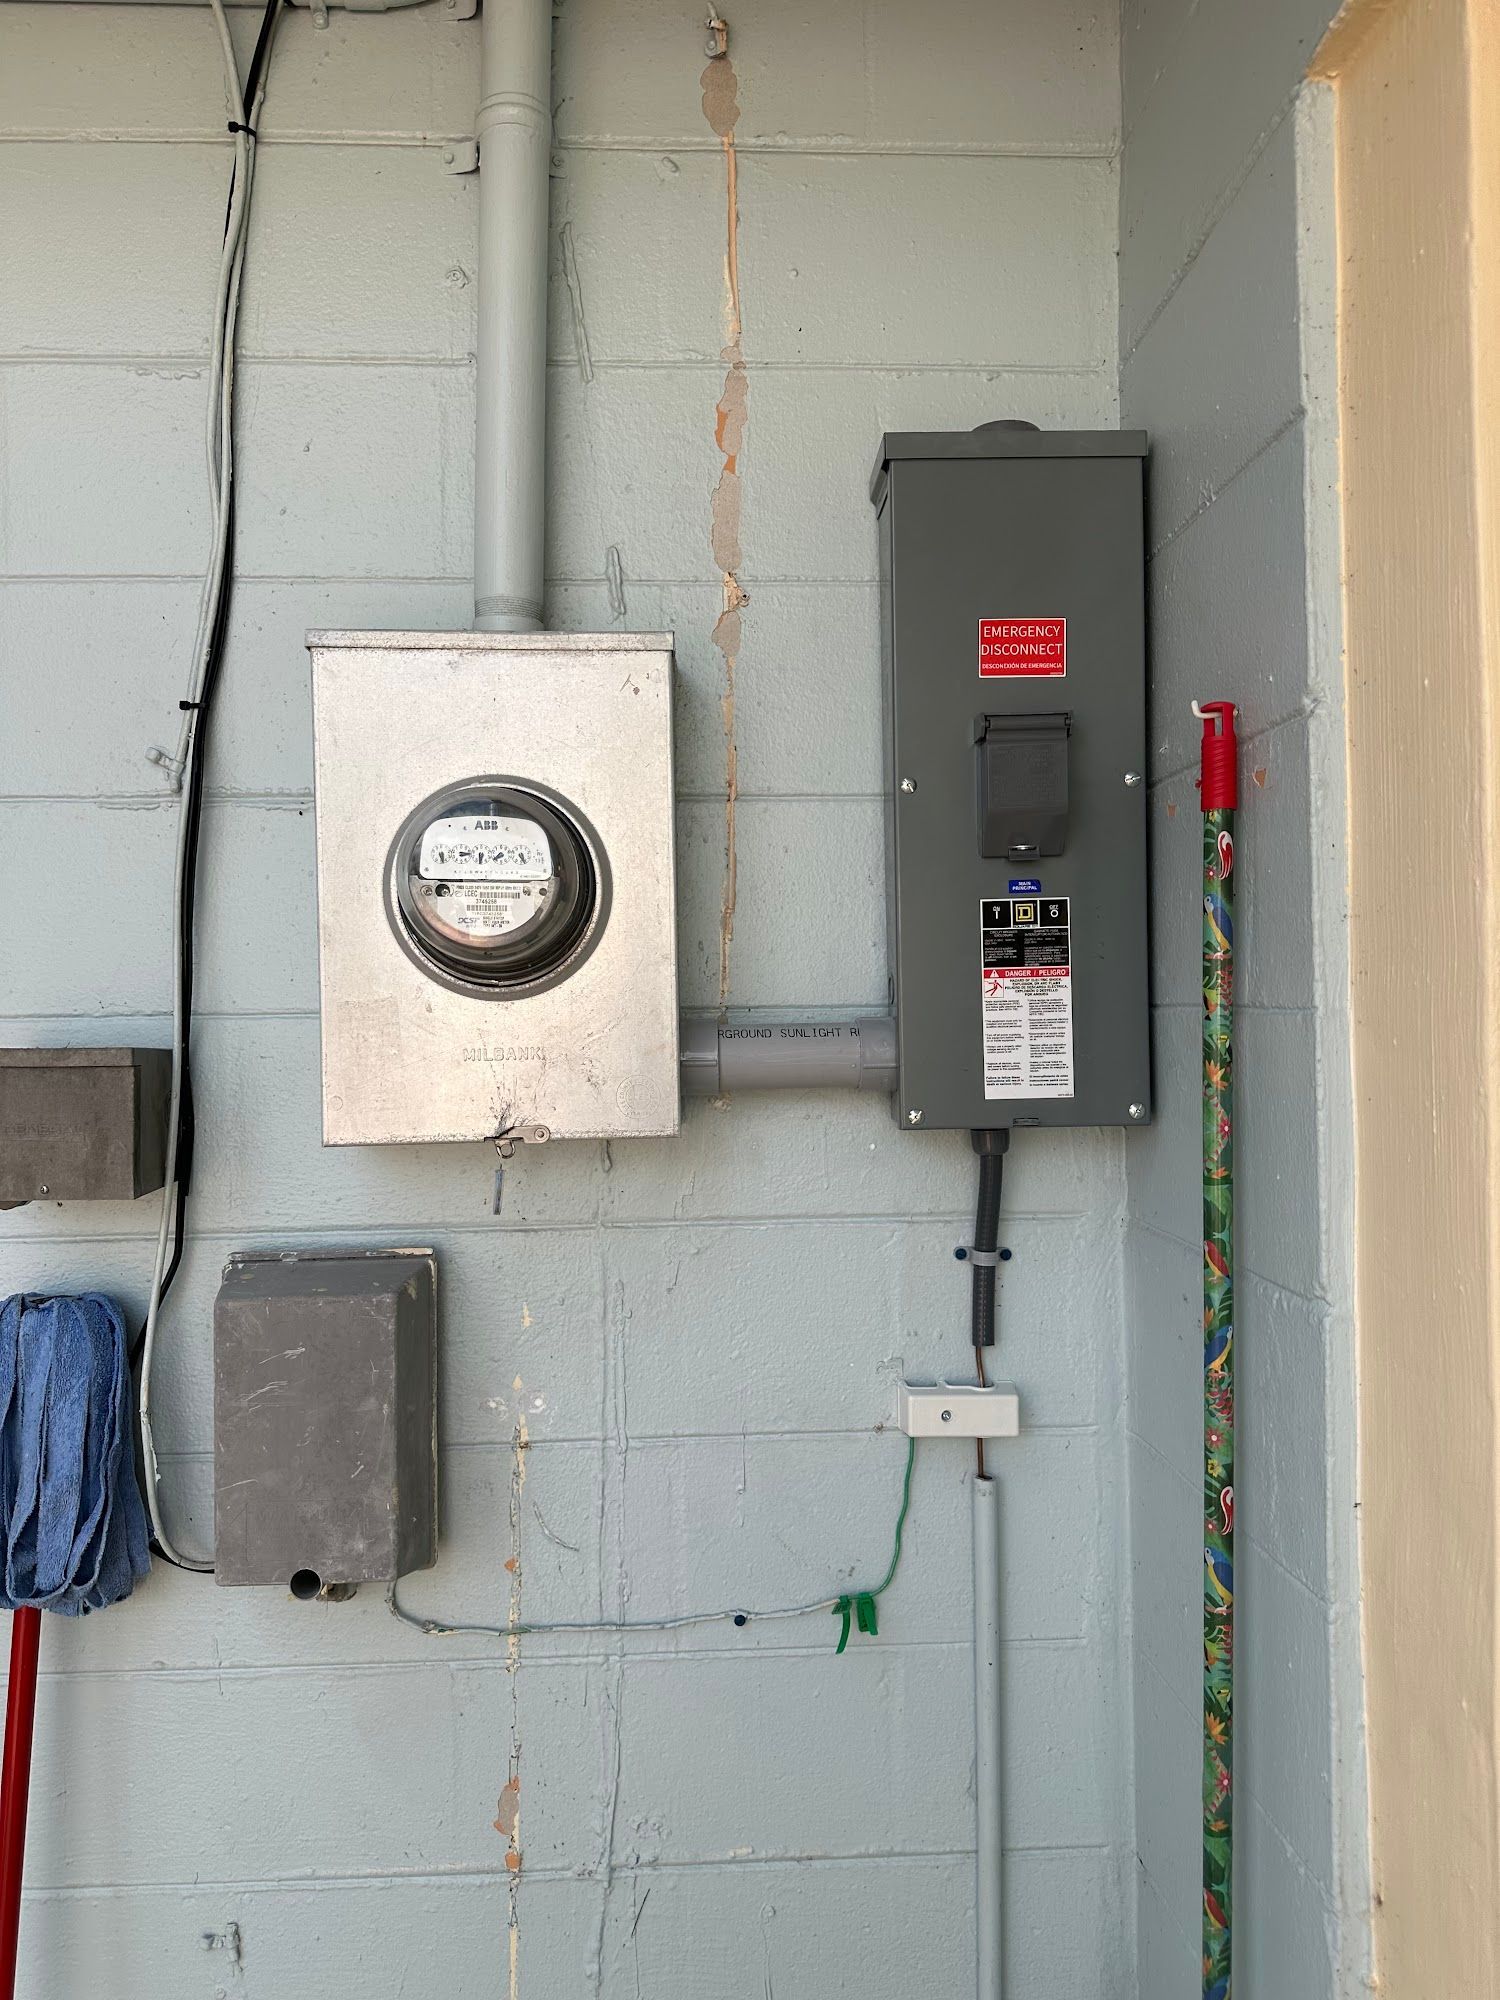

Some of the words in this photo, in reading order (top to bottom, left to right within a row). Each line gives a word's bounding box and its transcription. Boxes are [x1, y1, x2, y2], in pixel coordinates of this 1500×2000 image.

[983, 625, 1061, 638] EMERGENCY
[981, 643, 1063, 656] DISCONNECT
[475, 820, 499, 831] ABB
[780, 1028, 842, 1038] SUNLIGHT
[850, 1028, 861, 1037] R
[463, 1046, 542, 1062] MILBANK
